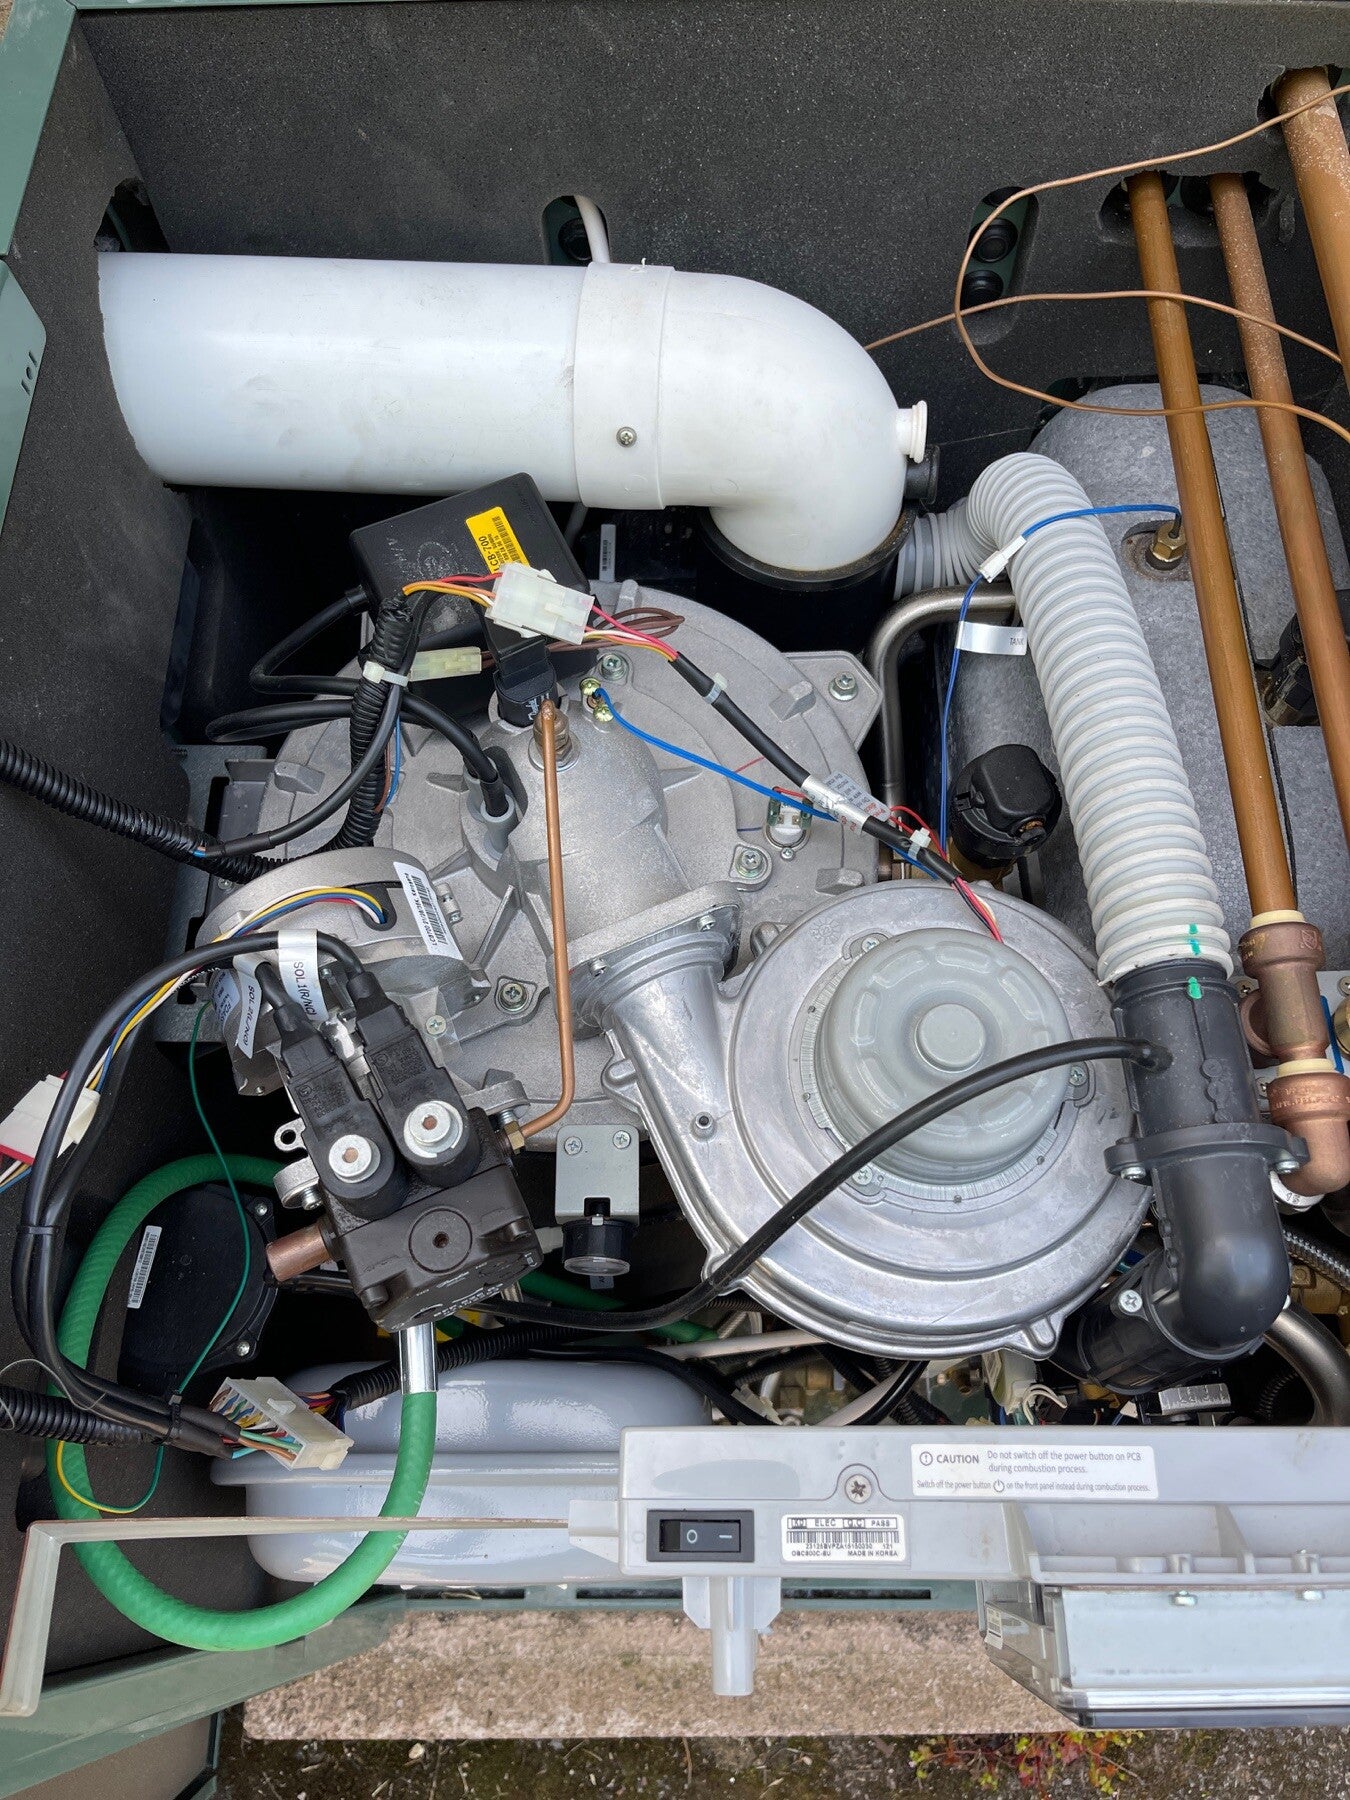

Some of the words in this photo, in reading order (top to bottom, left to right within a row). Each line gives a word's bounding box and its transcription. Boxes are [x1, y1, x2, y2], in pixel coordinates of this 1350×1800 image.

[293, 960, 305, 982] SOL
[937, 1455, 979, 1464] CAUTION
[1014, 1451, 1036, 1460] switch
[1038, 1451, 1049, 1460] off
[1050, 1452, 1062, 1460] the
[1064, 1453, 1087, 1462] power
[1089, 1452, 1114, 1461] button
[1127, 1453, 1141, 1461] PCB
[989, 1465, 1012, 1474] during
[1014, 1465, 1056, 1473] combustion
[1058, 1466, 1087, 1474] process.
[917, 1480, 935, 1488] Switch
[936, 1480, 944, 1488] off
[945, 1480, 954, 1488] the
[955, 1482, 972, 1490] power
[973, 1481, 991, 1489] button
[1025, 1482, 1038, 1490] front
[1039, 1482, 1055, 1491] panel
[1055, 1482, 1076, 1490] instead
[1076, 1482, 1094, 1492] during
[1095, 1483, 1126, 1491] combustion
[1127, 1484, 1150, 1492] process.
